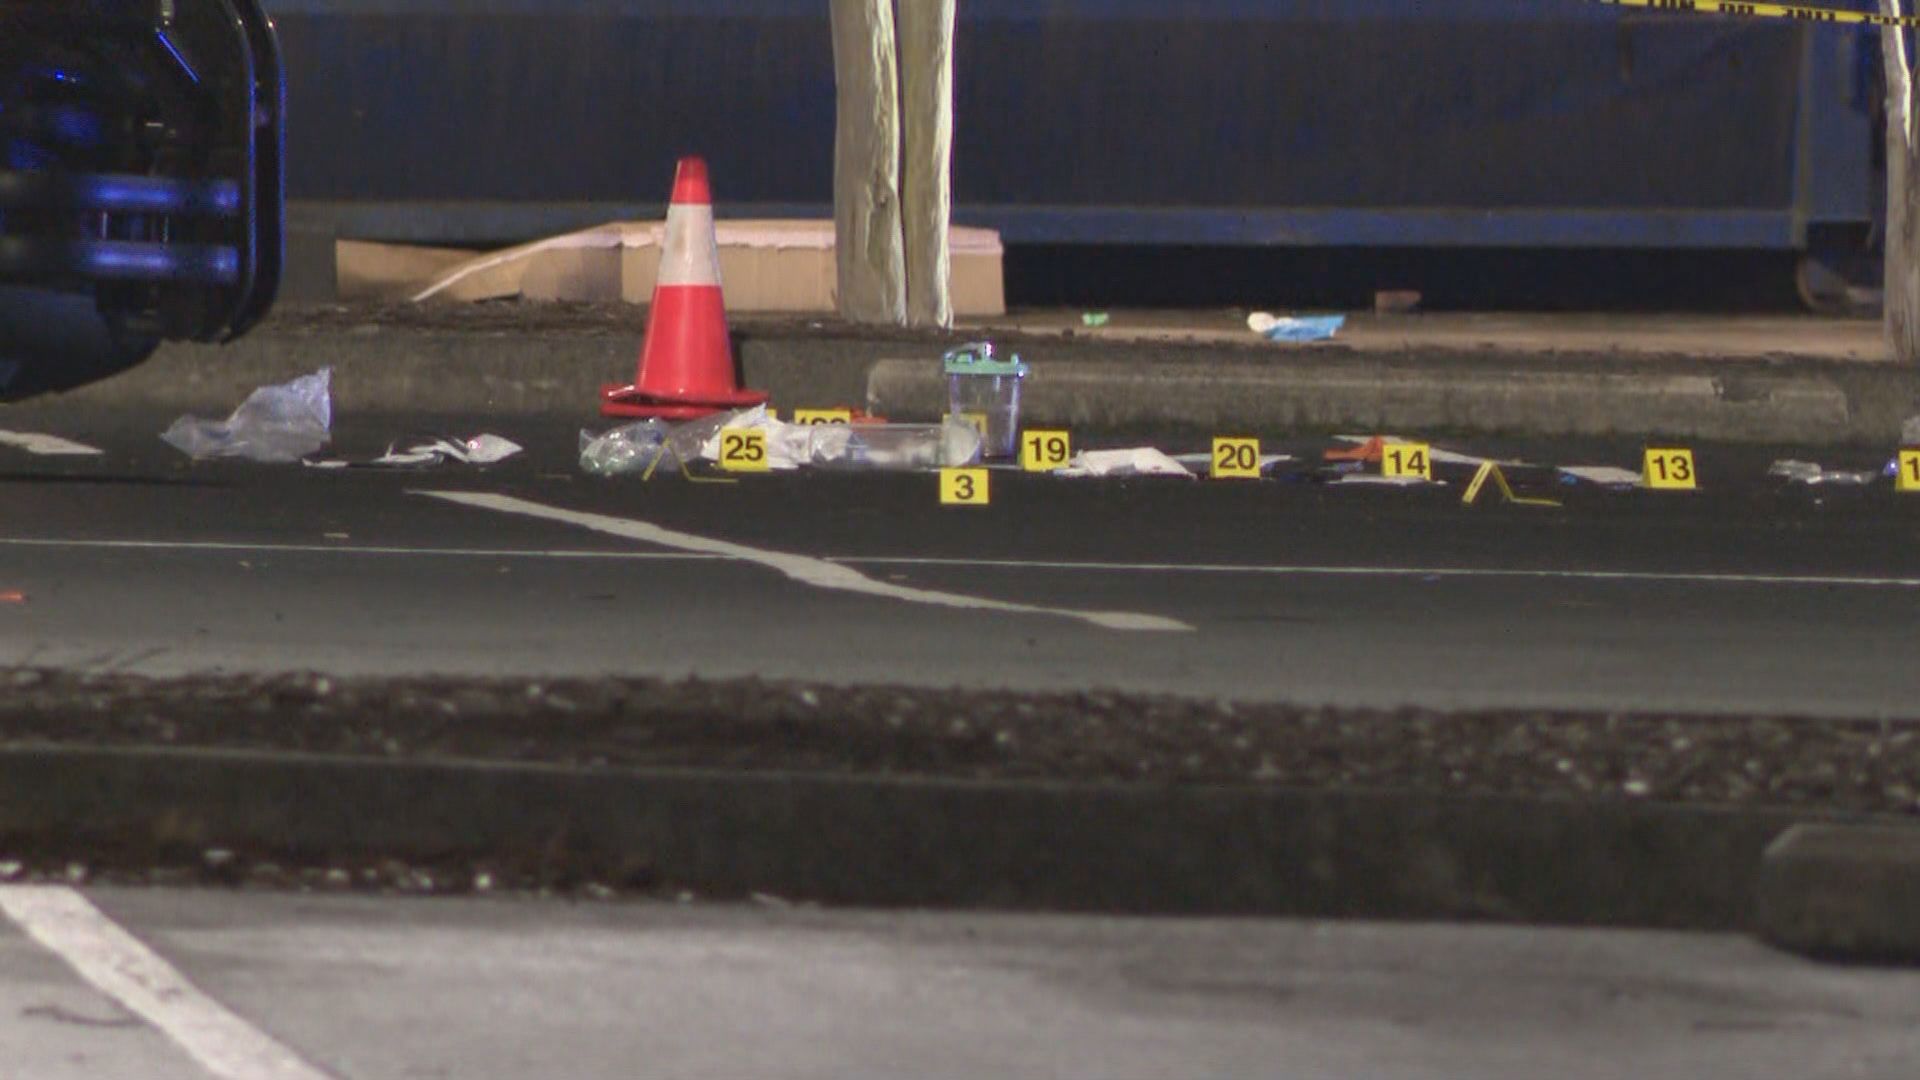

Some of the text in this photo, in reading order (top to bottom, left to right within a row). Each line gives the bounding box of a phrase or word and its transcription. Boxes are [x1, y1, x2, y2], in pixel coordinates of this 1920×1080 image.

[725, 435, 764, 461] 25
[1029, 437, 1066, 463] 19
[1218, 444, 1256, 470] 20
[1389, 450, 1429, 475] 14
[1653, 455, 1691, 481] 13
[955, 475, 974, 500] 3
